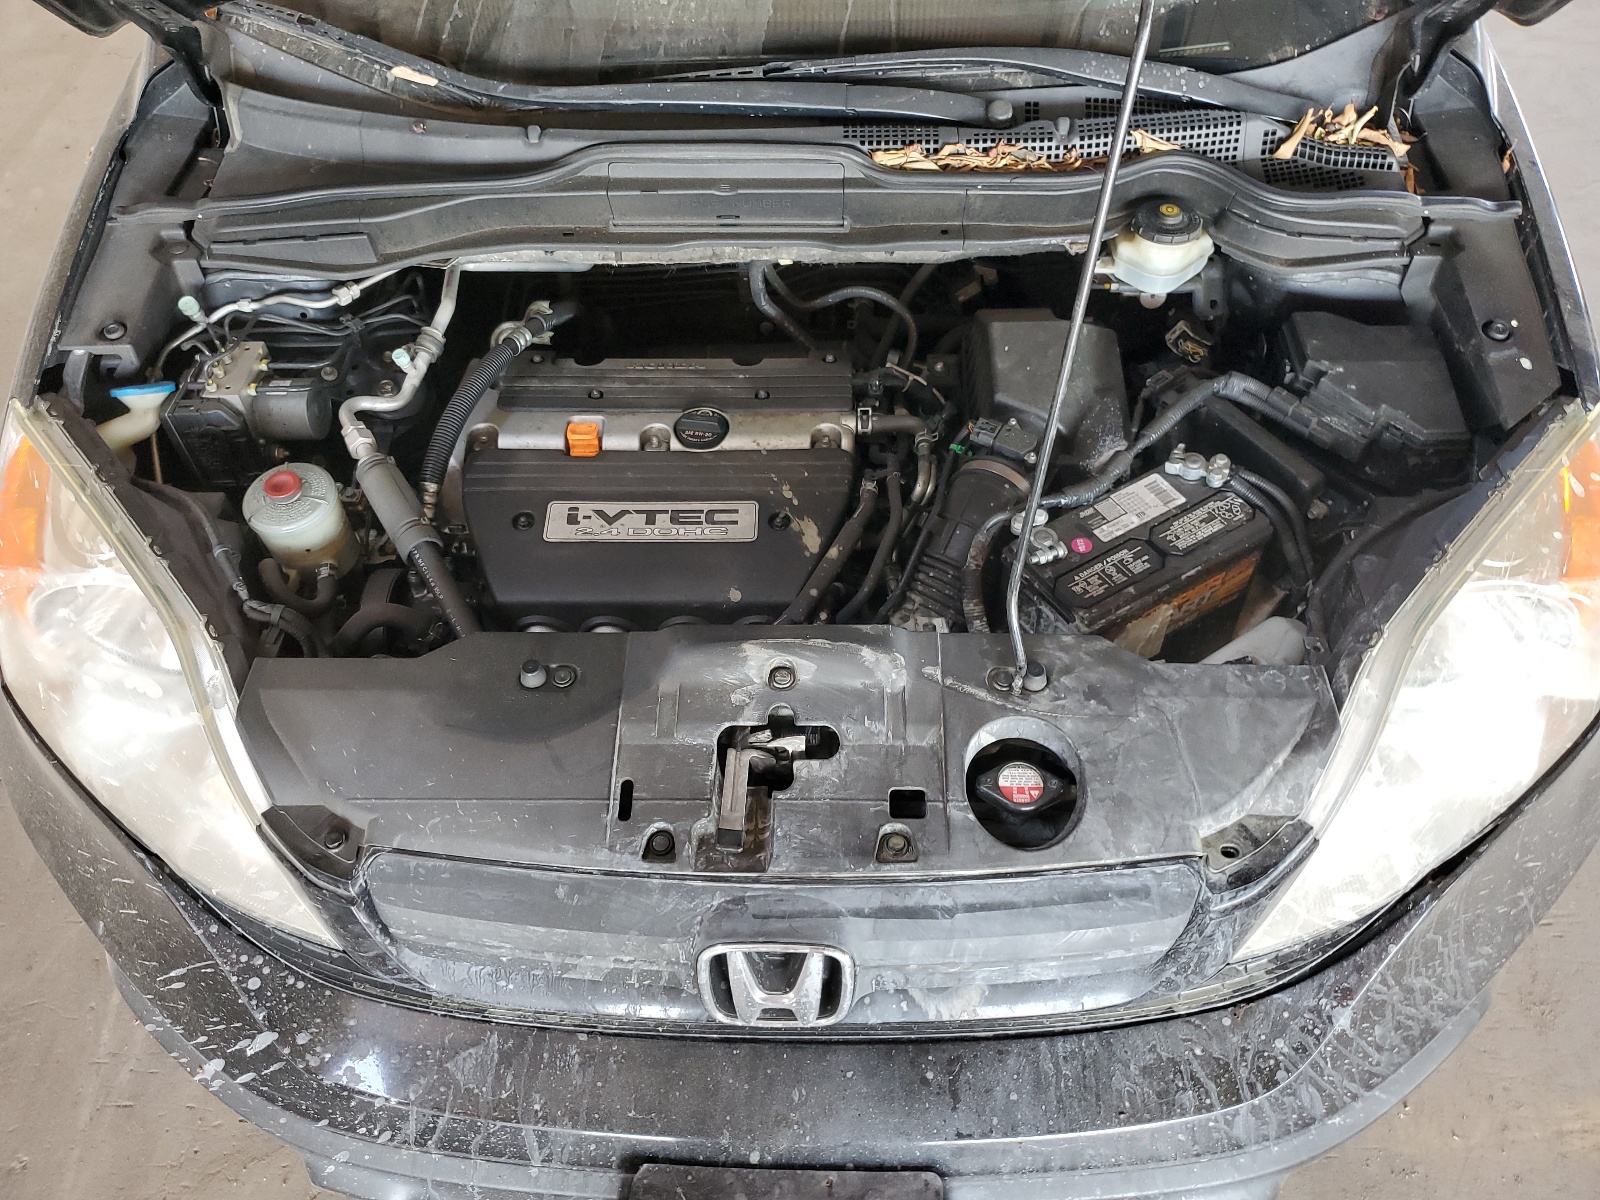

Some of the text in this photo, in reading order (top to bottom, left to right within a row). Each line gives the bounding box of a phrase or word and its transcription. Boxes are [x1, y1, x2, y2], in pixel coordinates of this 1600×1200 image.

[566, 507, 739, 526] i-VTEC
[575, 527, 728, 536] 2.4 DOHC
[1079, 562, 1103, 578] DANGER
[1106, 549, 1130, 563] POISON
